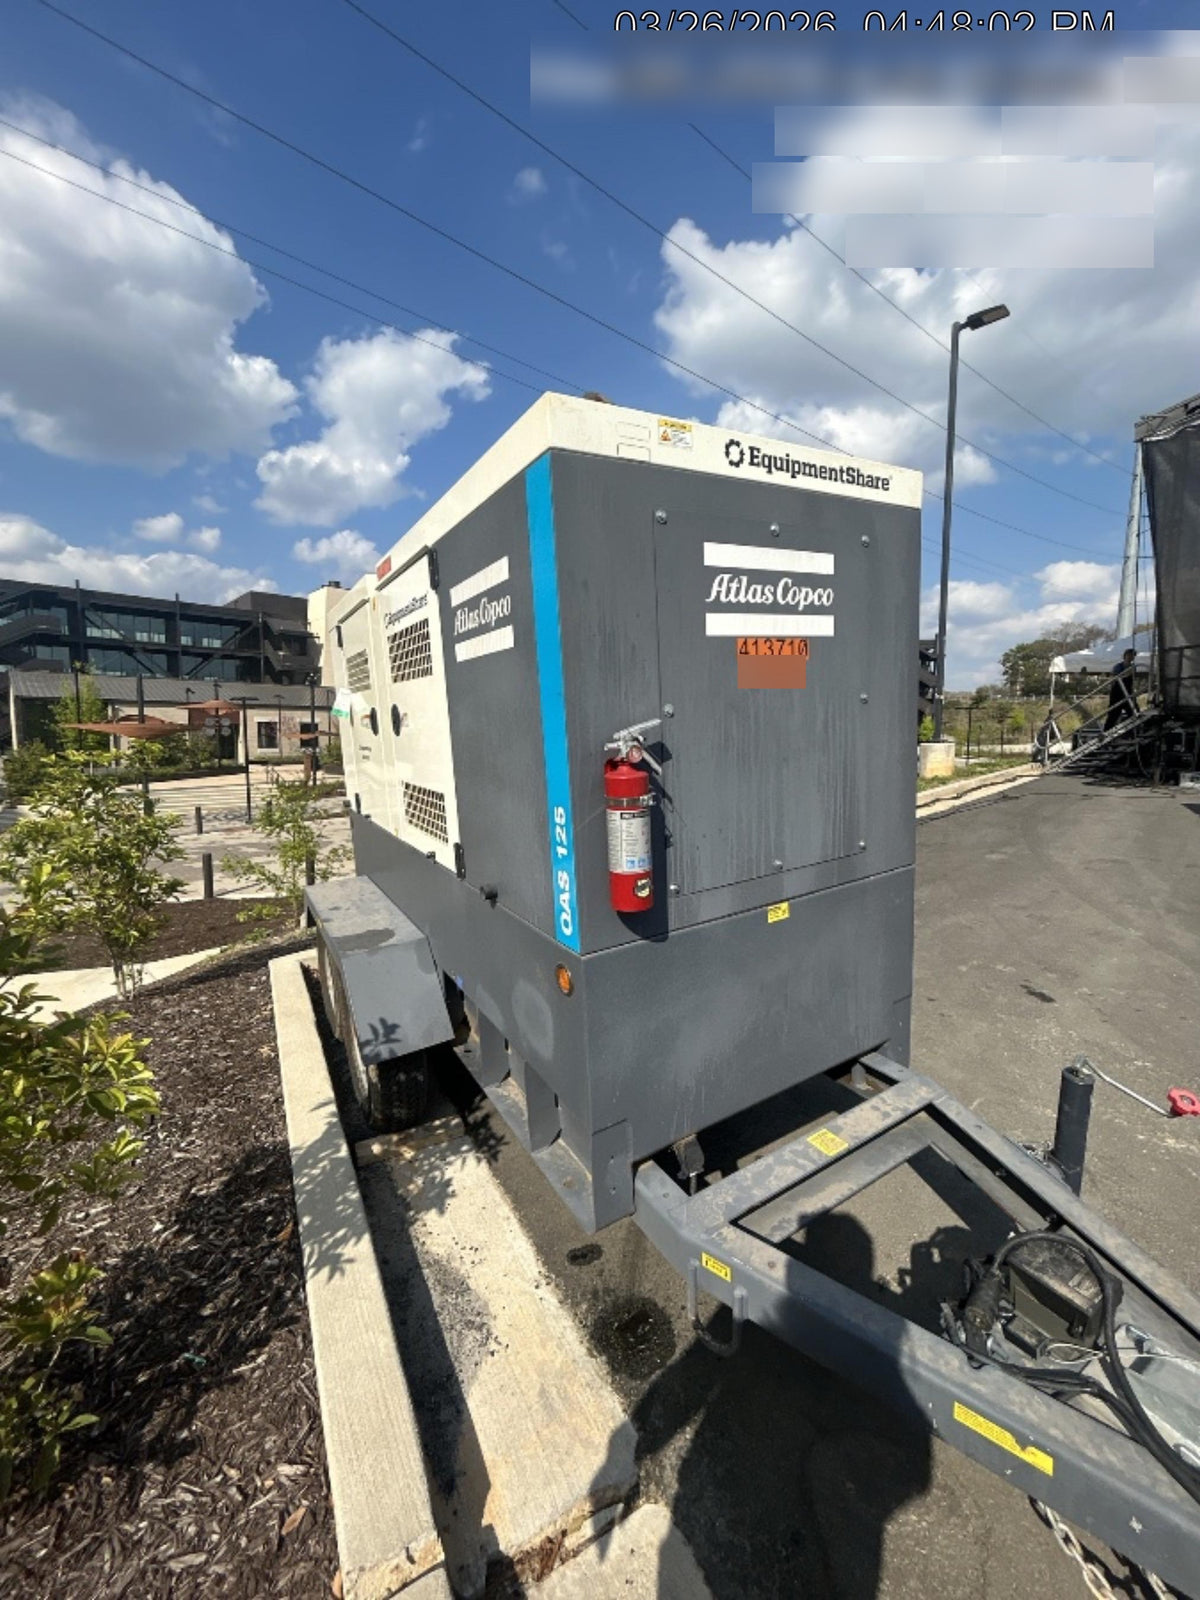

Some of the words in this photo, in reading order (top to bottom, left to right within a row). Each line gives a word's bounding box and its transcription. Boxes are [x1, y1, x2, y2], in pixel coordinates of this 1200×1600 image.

[748, 446, 890, 491] EquipmentShare
[705, 573, 774, 604] Atlas
[776, 577, 834, 611] Copco
[454, 606, 479, 635] Atlas
[480, 595, 511, 627] Copco
[739, 638, 808, 656] 413710
[554, 806, 568, 859] 125
[557, 870, 573, 936] QAS
